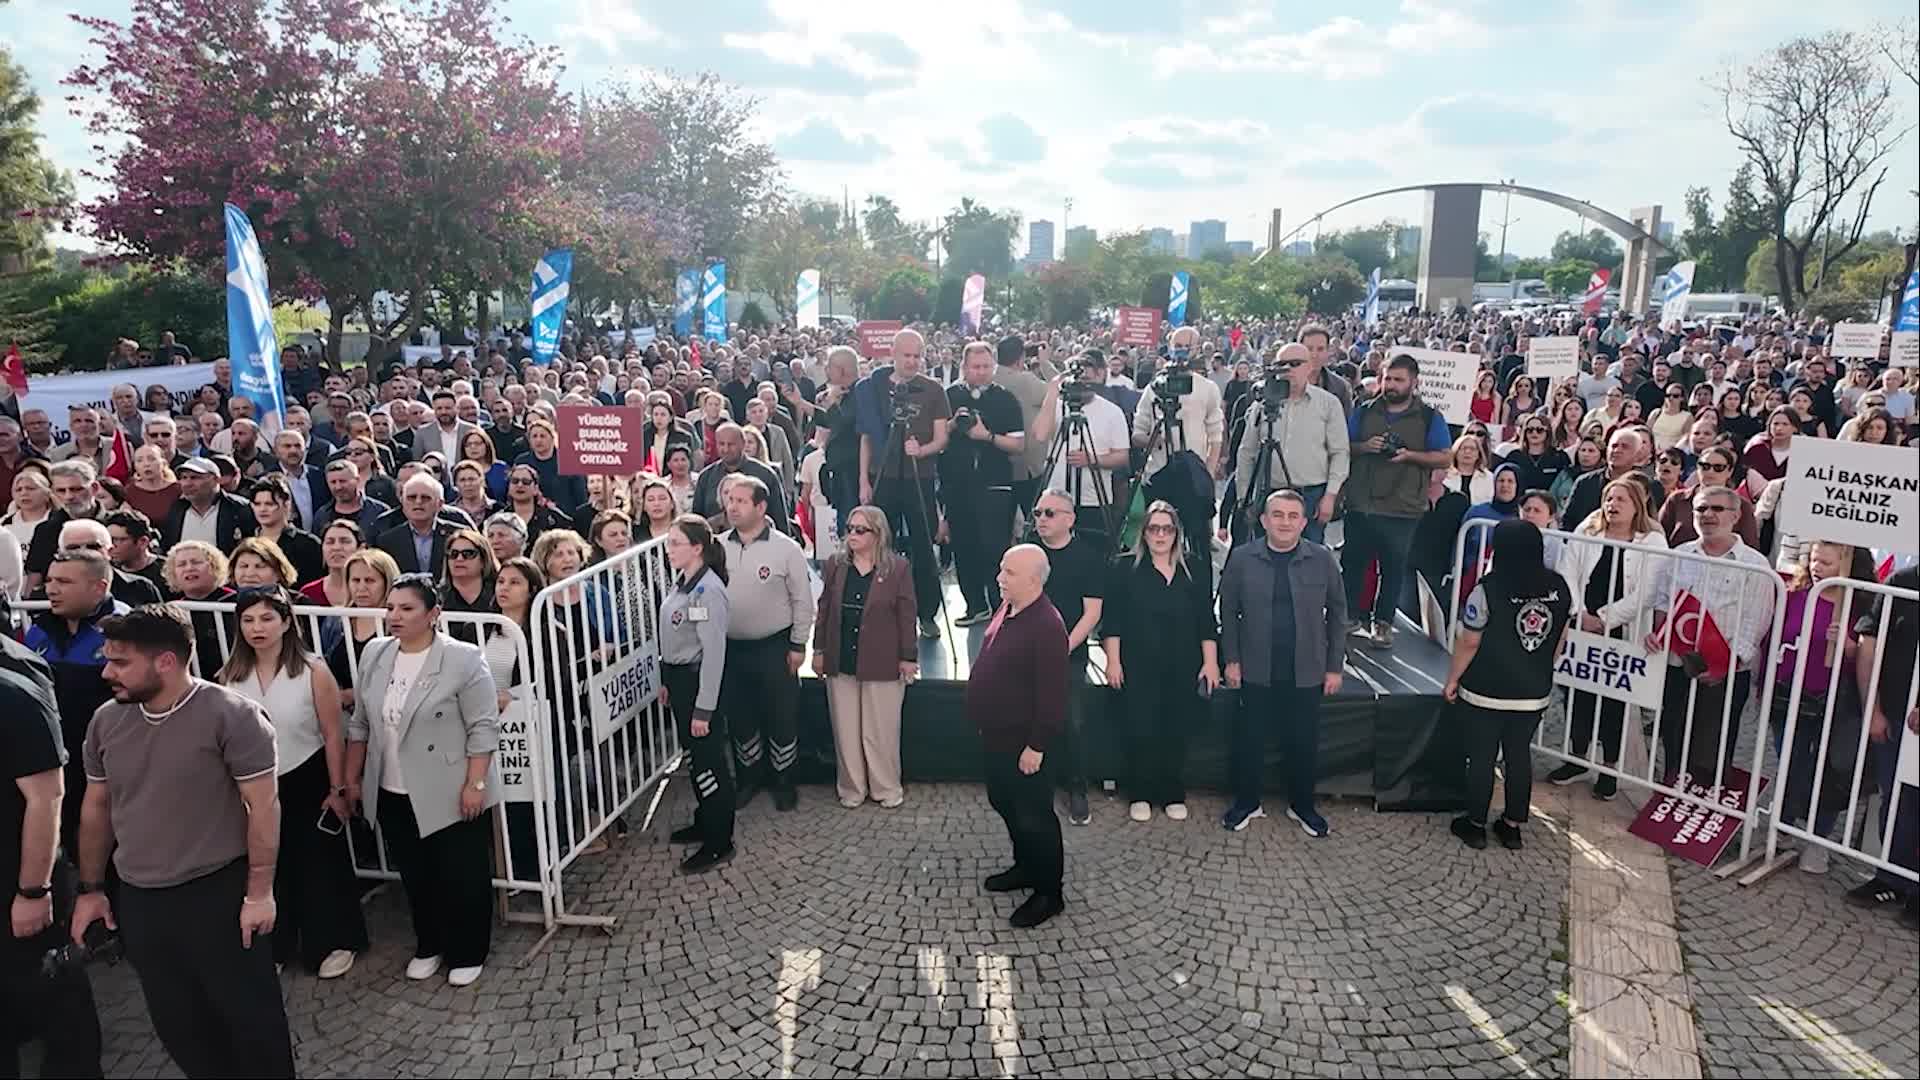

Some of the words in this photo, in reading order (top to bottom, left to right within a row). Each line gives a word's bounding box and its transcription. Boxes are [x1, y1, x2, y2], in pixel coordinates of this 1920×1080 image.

[1425, 380, 1466, 391] VERENLER
[577, 412, 622, 426] YÜREĞİR
[578, 429, 621, 440] BURADA
[572, 439, 629, 453] YÜREĞİMİZ
[579, 454, 622, 465] ORTADA
[1805, 465, 1834, 481] ALİ
[1838, 470, 1918, 492] BAŞKAN
[1825, 486, 1891, 508] YALNIZ
[1811, 502, 1899, 527] DEĞİLDİR
[602, 655, 654, 704] YÜREĞİR
[1553, 659, 1632, 692] ABITA
[609, 677, 651, 721] ZABITA
[499, 739, 527, 751] EYE
[501, 752, 531, 768] İNİZ
[504, 773, 523, 785] EZ
